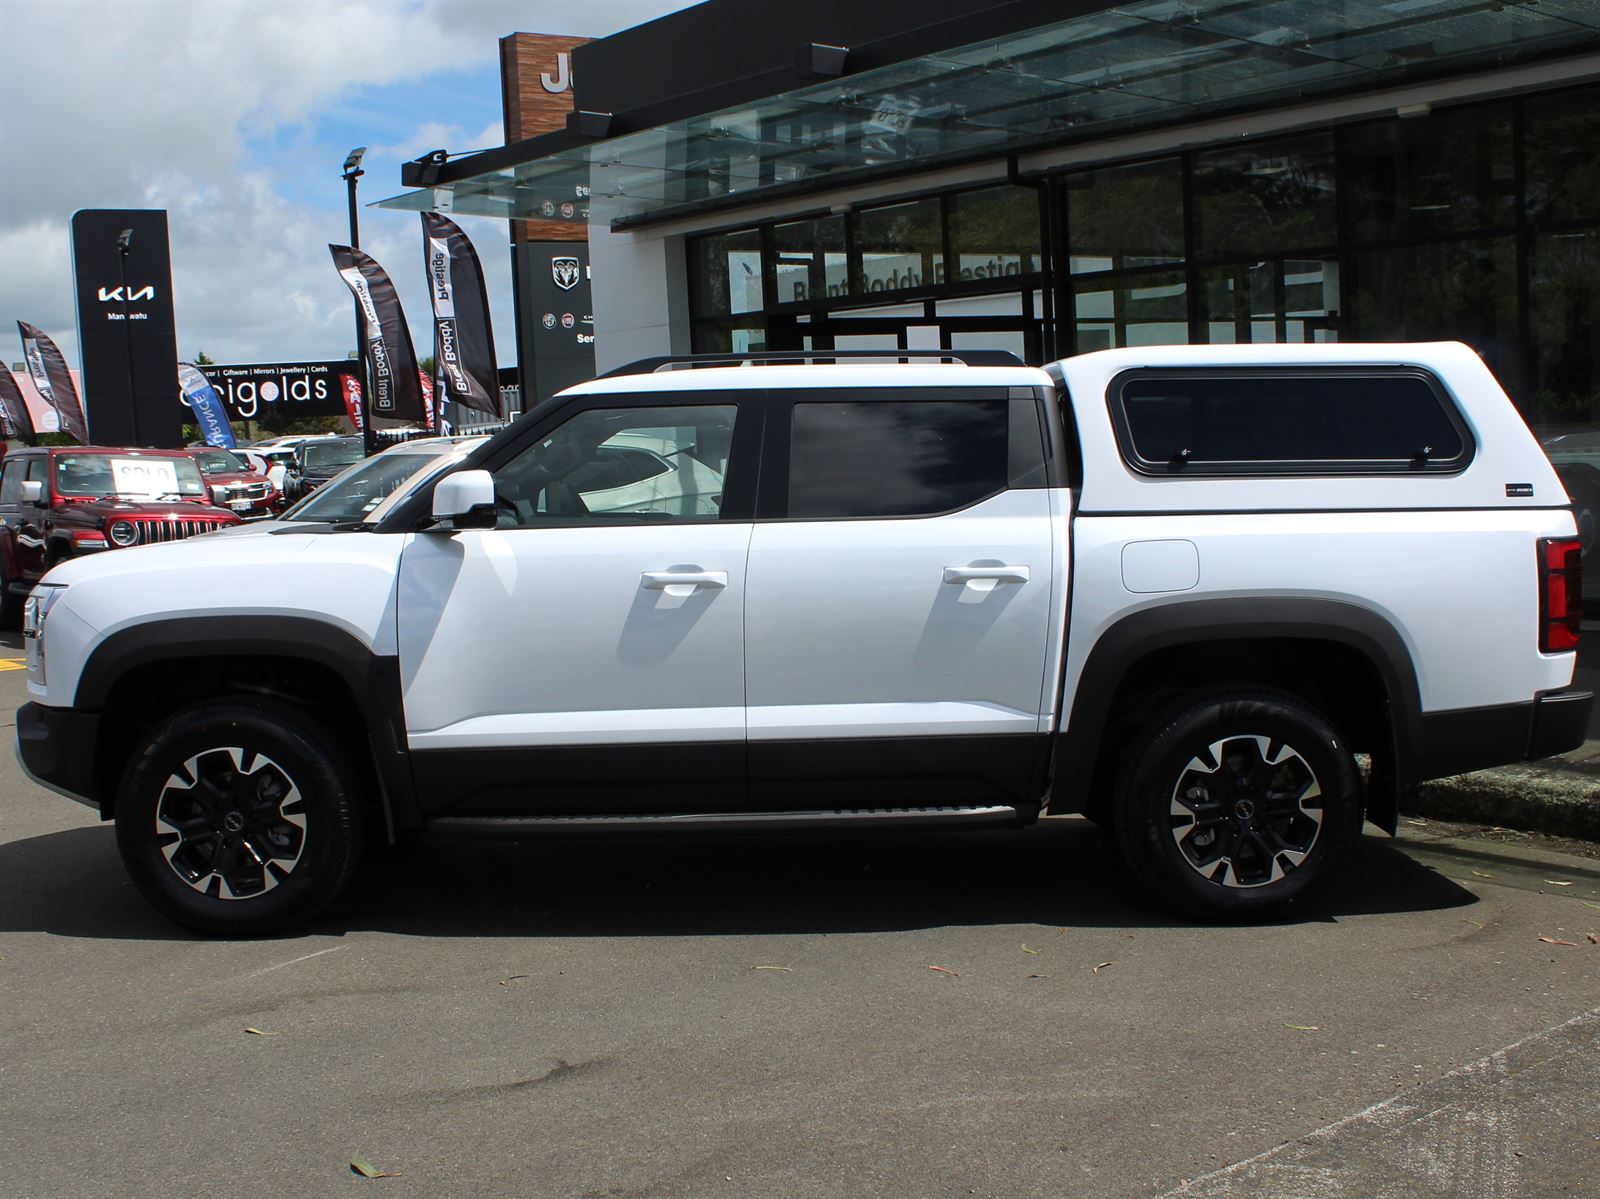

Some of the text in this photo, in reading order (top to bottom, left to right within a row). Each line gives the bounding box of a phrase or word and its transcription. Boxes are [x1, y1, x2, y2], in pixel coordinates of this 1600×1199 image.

[541, 52, 574, 93] J
[253, 367, 275, 375] Mirrors
[280, 366, 306, 374] Jewellery
[310, 365, 328, 373] Cards
